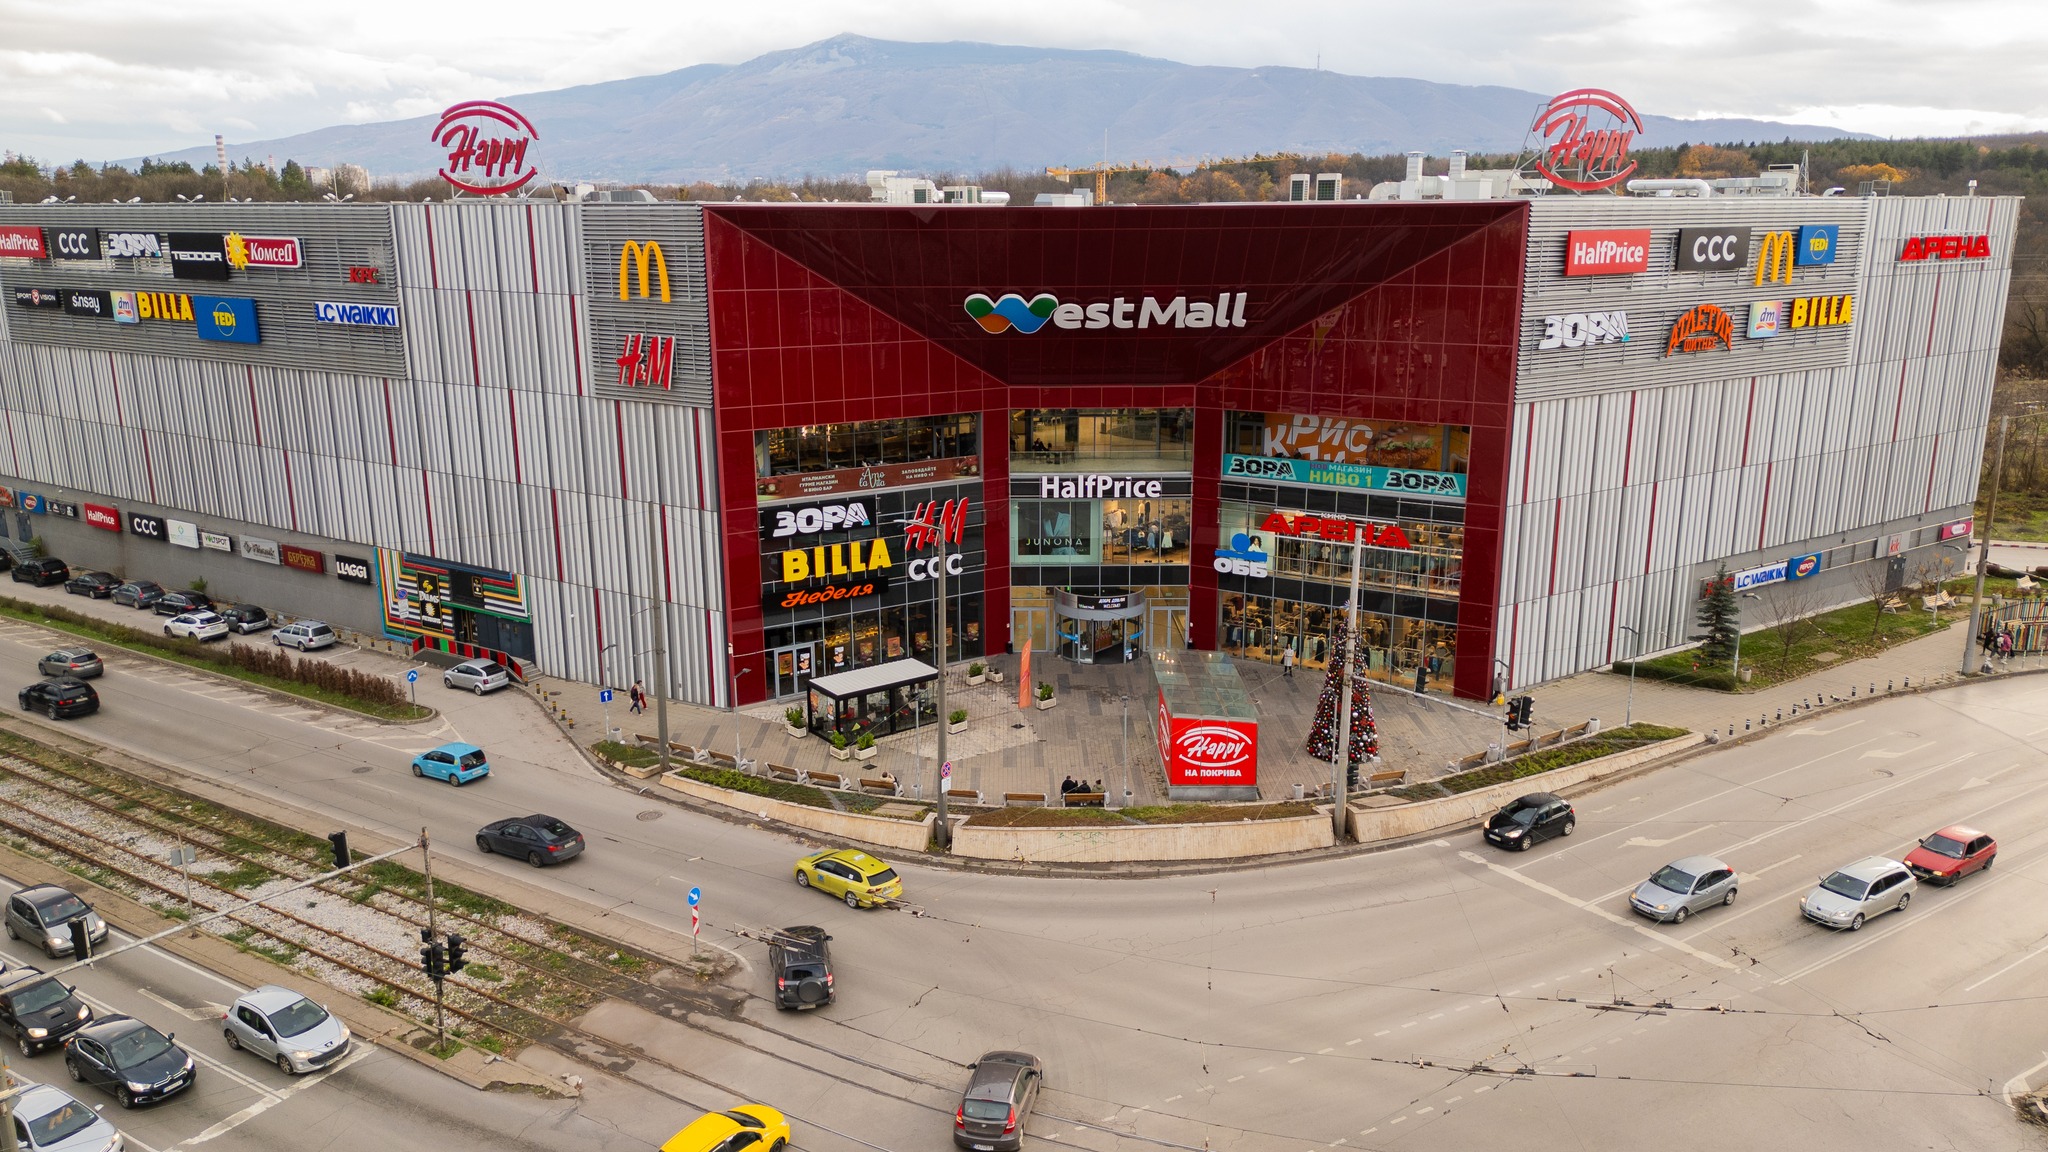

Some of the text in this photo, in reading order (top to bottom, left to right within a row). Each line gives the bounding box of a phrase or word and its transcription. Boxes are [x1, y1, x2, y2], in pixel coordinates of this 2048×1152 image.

[441, 124, 529, 177] Happy
[1544, 112, 1635, 172] Happy
[0, 233, 39, 251] HalfPrice
[58, 232, 89, 254] CCC
[1573, 240, 1644, 265] HalfPrice
[1693, 235, 1738, 263] CCC
[1900, 235, 1991, 262] АРЕНА
[171, 251, 222, 261] TEODOR
[350, 267, 379, 284] KFC
[118, 298, 130, 309] dm
[137, 291, 194, 320] BILLA
[316, 302, 335, 322] LC
[1760, 307, 1775, 322] dm
[1791, 295, 1852, 328] BILLA
[1538, 310, 1630, 349] ЗОРА
[616, 333, 675, 391] H&M
[1230, 457, 1294, 478] ЗОРА
[1309, 470, 1372, 487] НИВО 1
[1328, 463, 1372, 474] МАГАЗИН
[1040, 474, 1161, 498] HalfPrice
[1385, 472, 1457, 493] ЗОРА
[87, 510, 115, 525] HalfPrice
[134, 517, 157, 536] CCC
[772, 502, 870, 537] ЗОРА
[904, 496, 969, 551] H&M
[1321, 512, 1347, 520] КИНО
[1026, 538, 1083, 546] JUNONA
[782, 538, 892, 583] BILLA
[908, 553, 963, 581] CCC
[1737, 575, 1750, 589] LC
[781, 583, 874, 608] Неделя
[1183, 735, 1245, 760] Happy
[1184, 769, 1242, 777] НА ПОКРИВА
